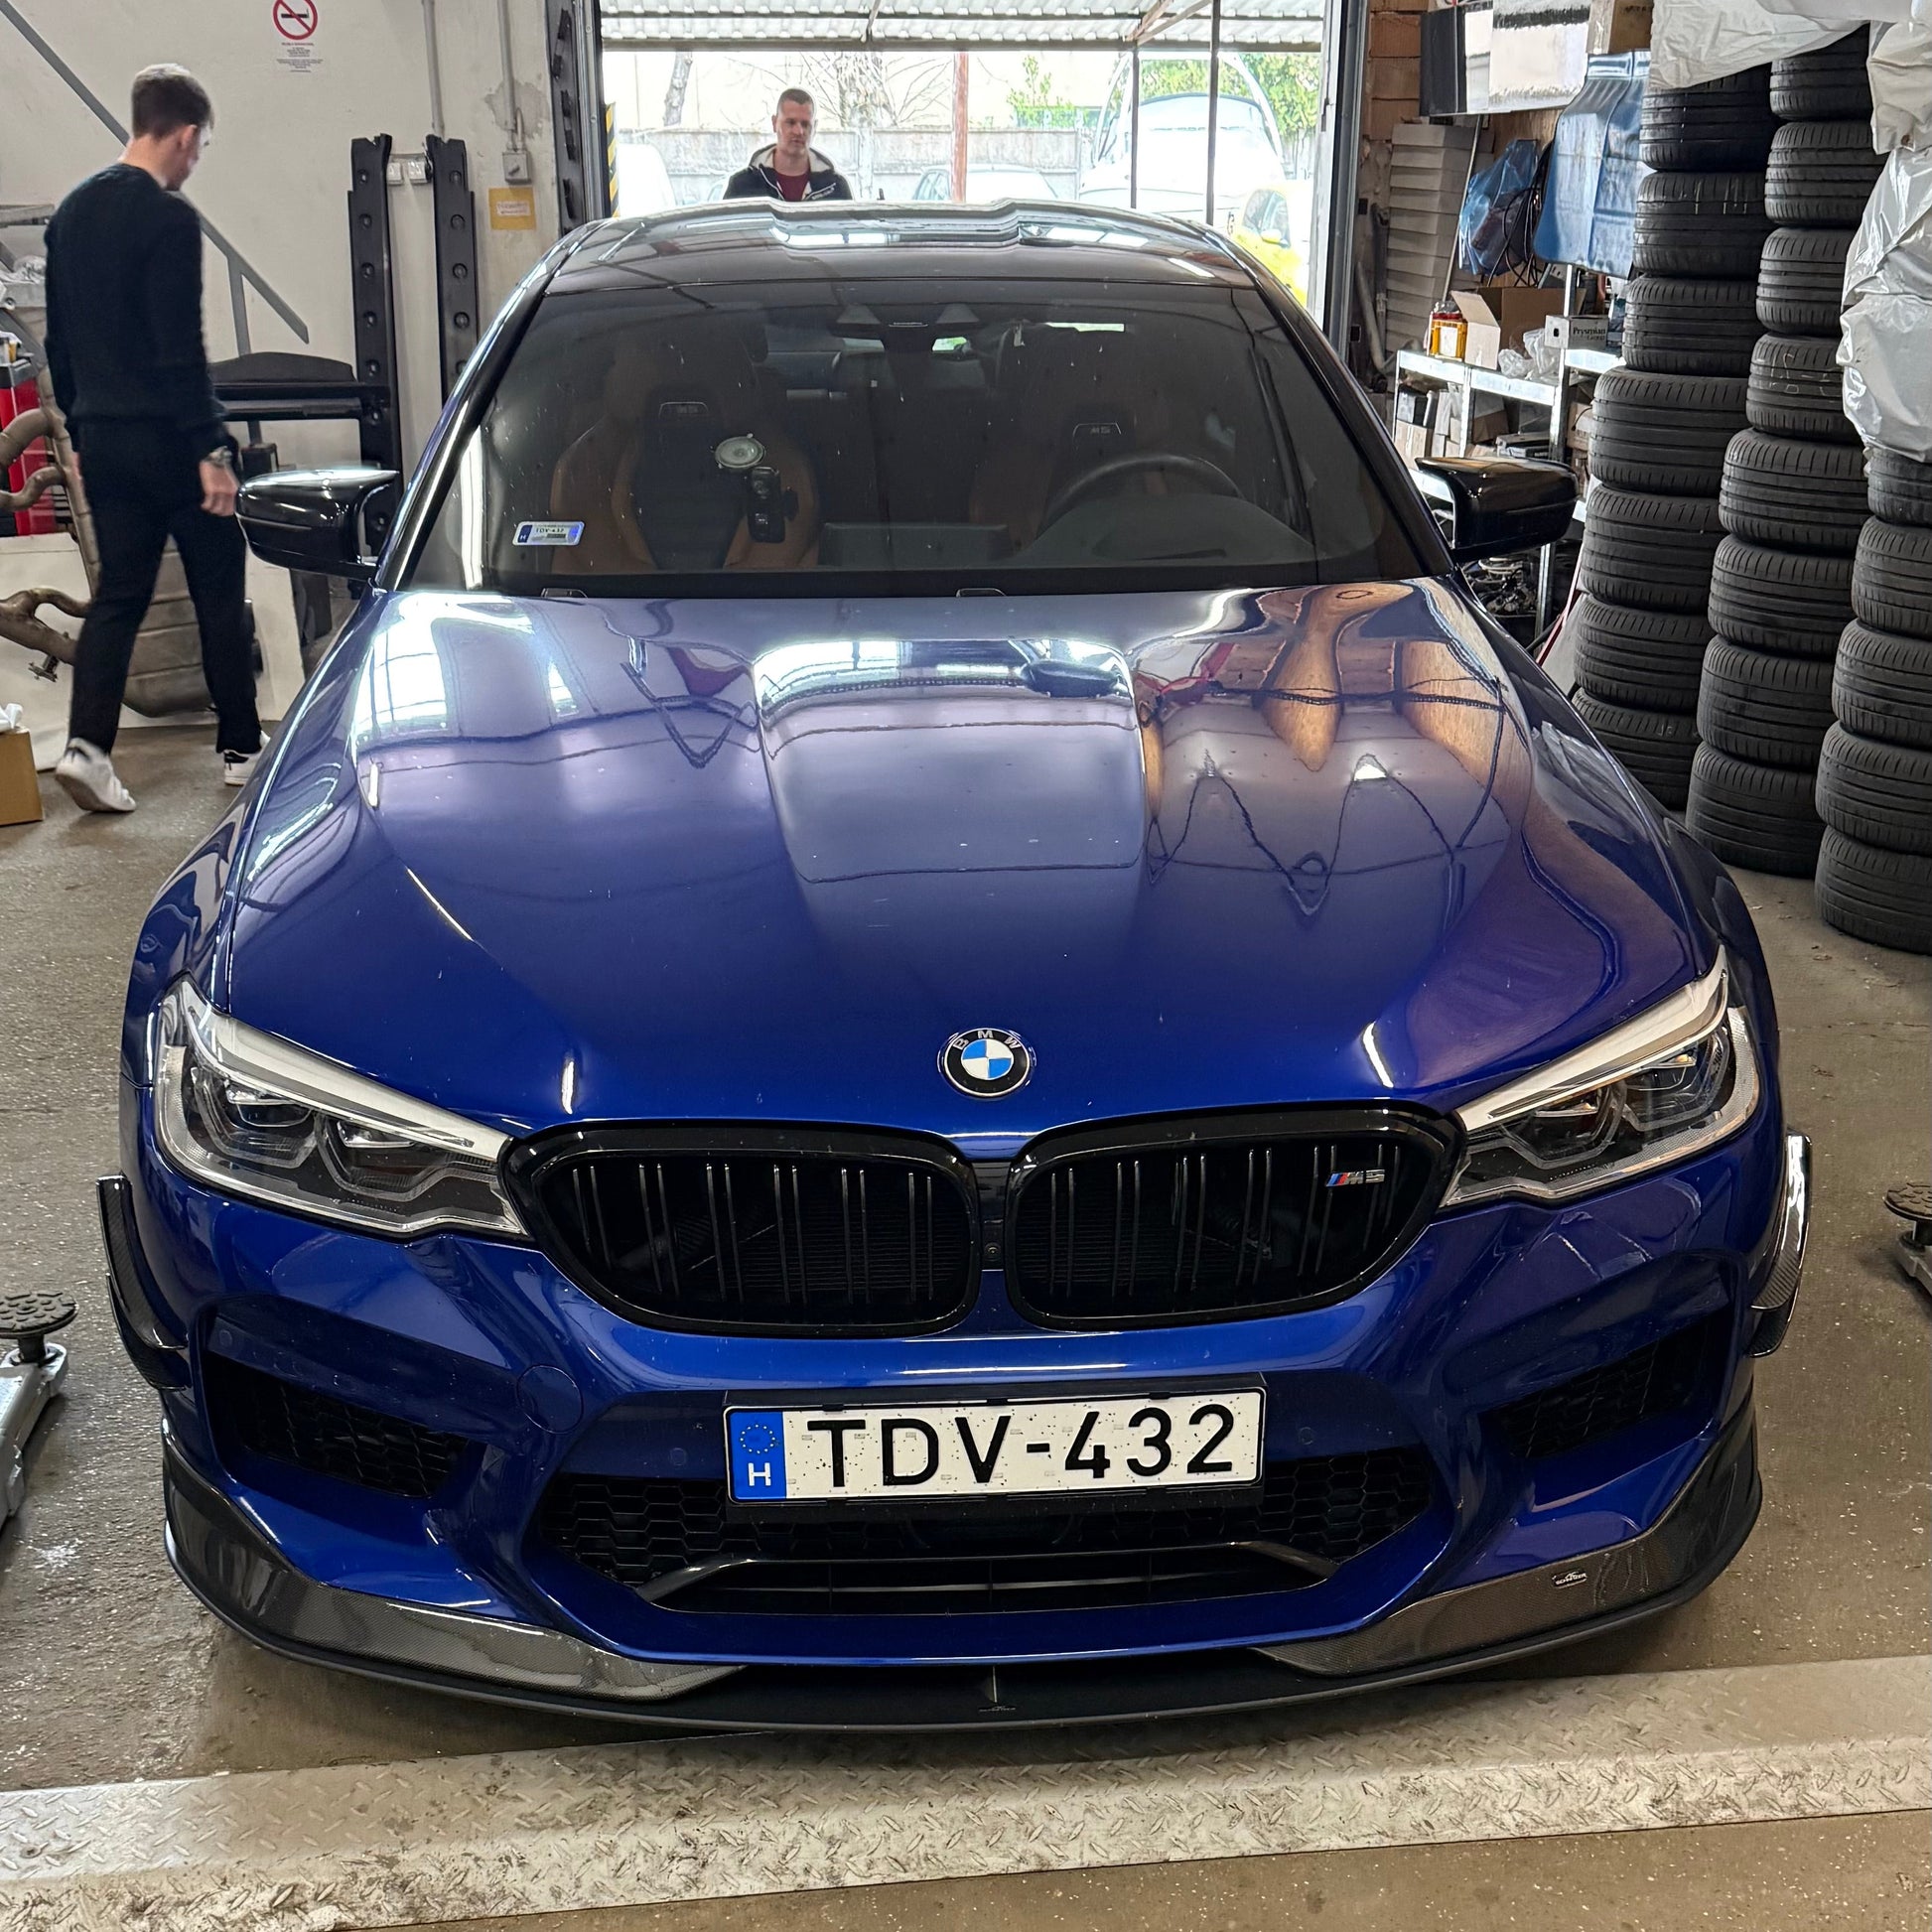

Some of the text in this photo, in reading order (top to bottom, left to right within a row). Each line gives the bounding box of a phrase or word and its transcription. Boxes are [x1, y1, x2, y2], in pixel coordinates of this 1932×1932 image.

[1573, 327, 1606, 337] Prysmian
[952, 1030, 1022, 1050] BMW
[1342, 1169, 1385, 1185] M5
[807, 1404, 1234, 1487] TDV-432
[749, 1462, 771, 1486] H
